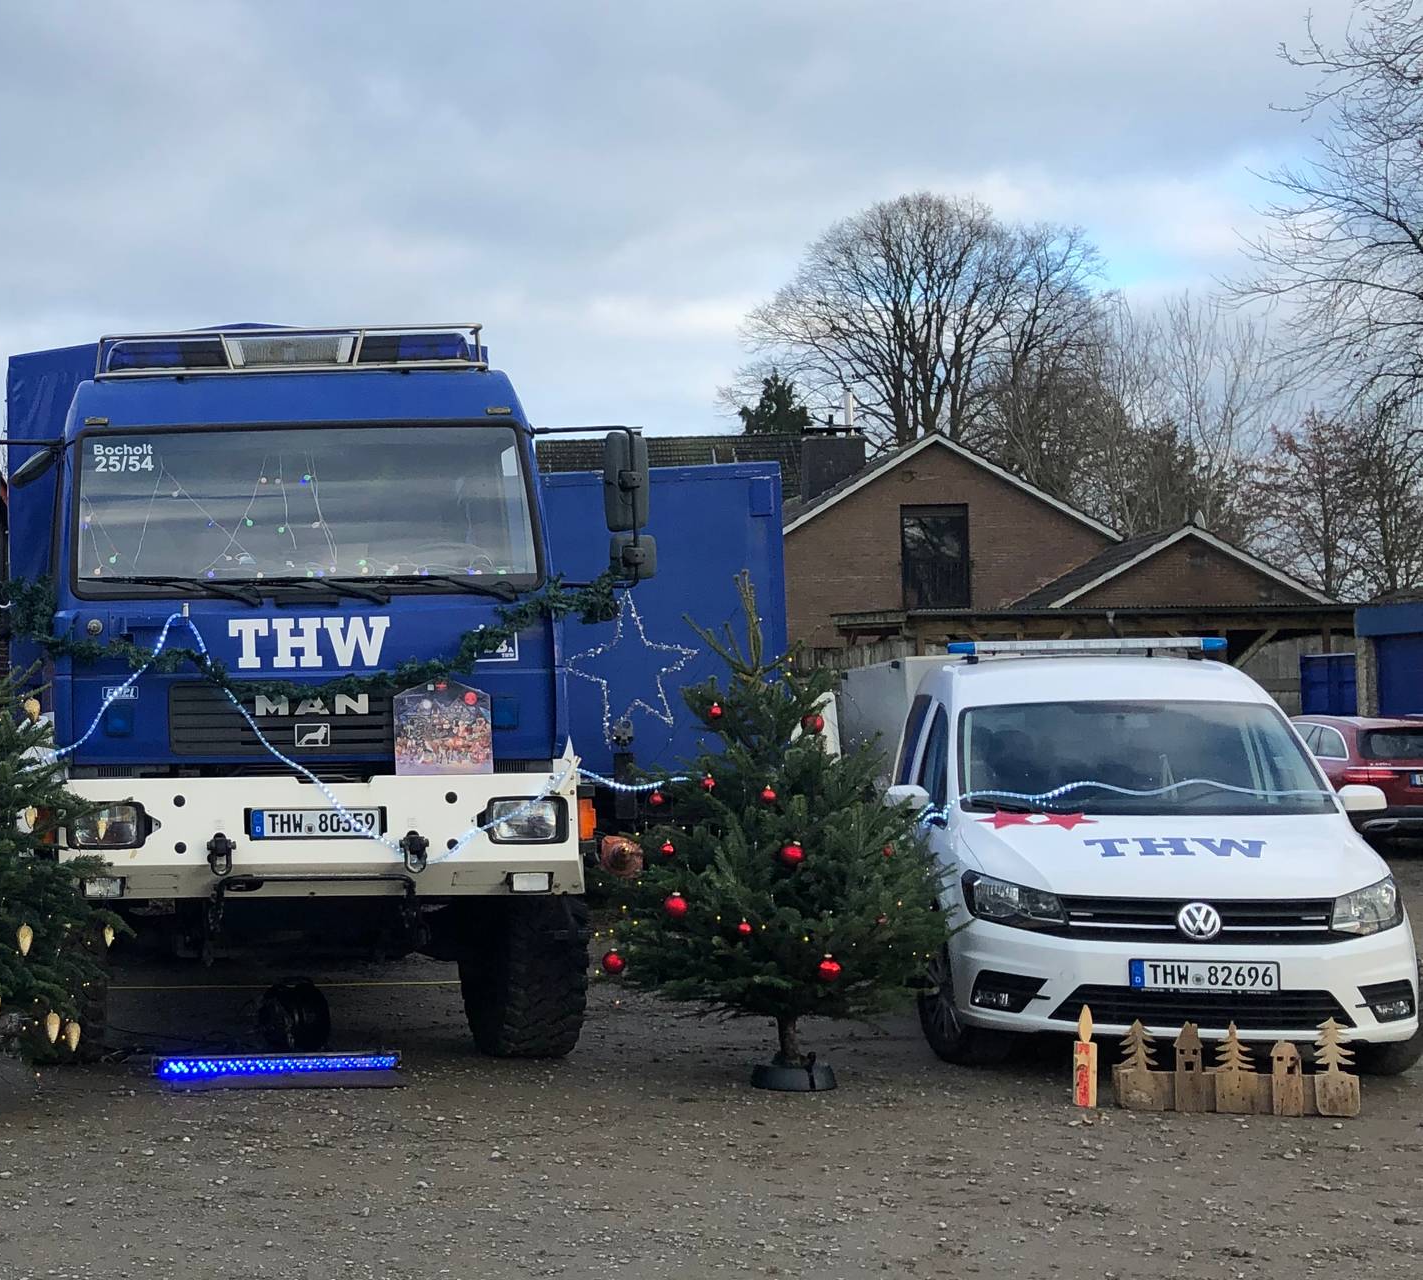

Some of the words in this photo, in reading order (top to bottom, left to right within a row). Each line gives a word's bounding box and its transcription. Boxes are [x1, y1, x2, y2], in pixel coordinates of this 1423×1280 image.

[93, 443, 154, 456] Bocholt
[94, 455, 155, 472] 25/54
[228, 616, 391, 669] THW
[255, 693, 369, 716] MAN
[267, 813, 303, 833] THW
[1083, 837, 1267, 859] THW
[1149, 963, 1189, 985] THW
[1207, 965, 1274, 987] 82696
